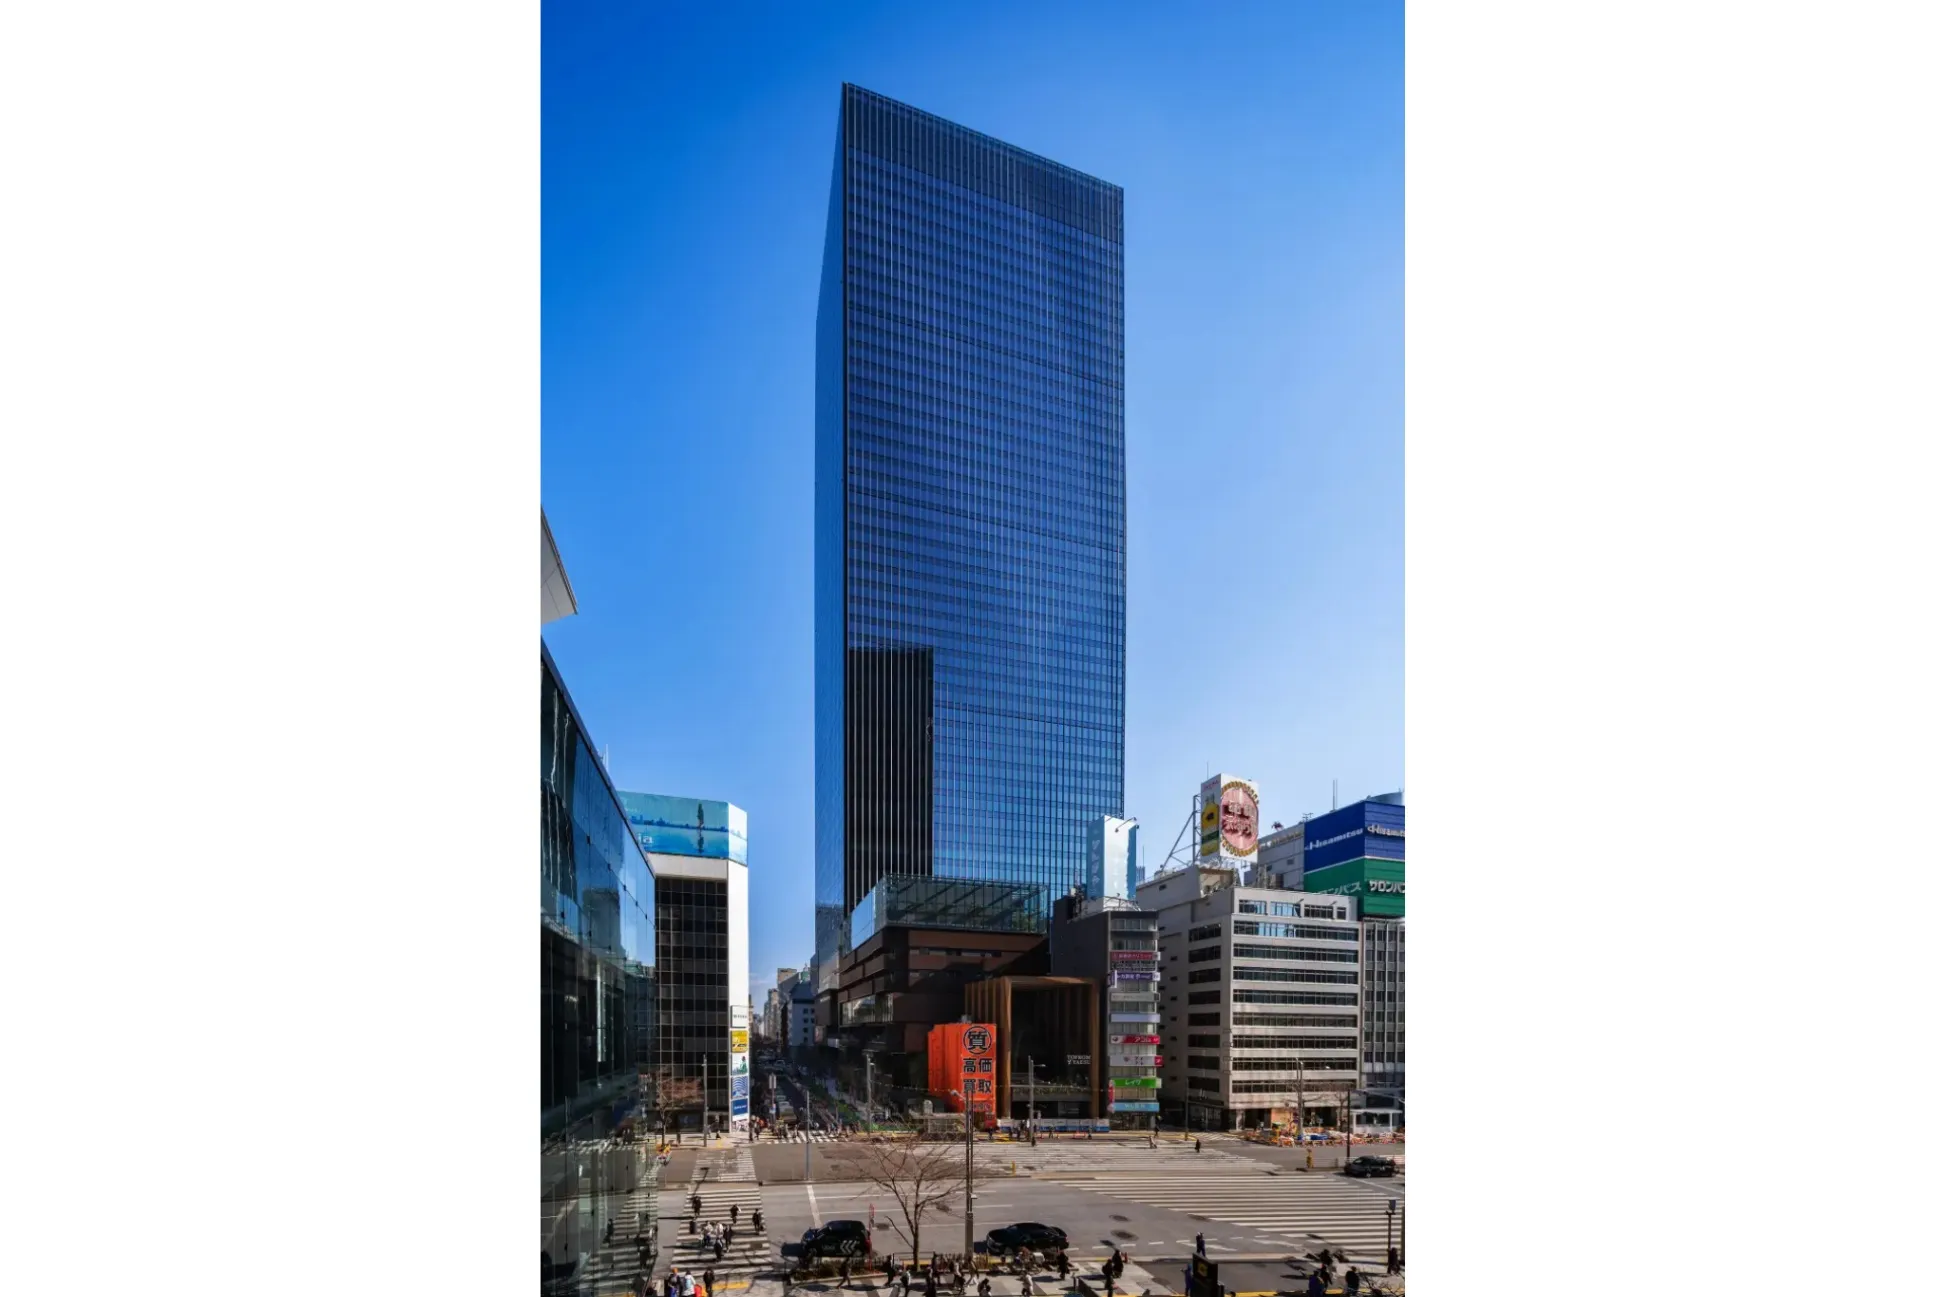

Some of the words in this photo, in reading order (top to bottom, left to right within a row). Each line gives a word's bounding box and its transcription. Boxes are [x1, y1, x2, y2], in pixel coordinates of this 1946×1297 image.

[966, 1030, 988, 1051] 質
[963, 1058, 992, 1073] 高価
[963, 1079, 992, 1094] 買取
